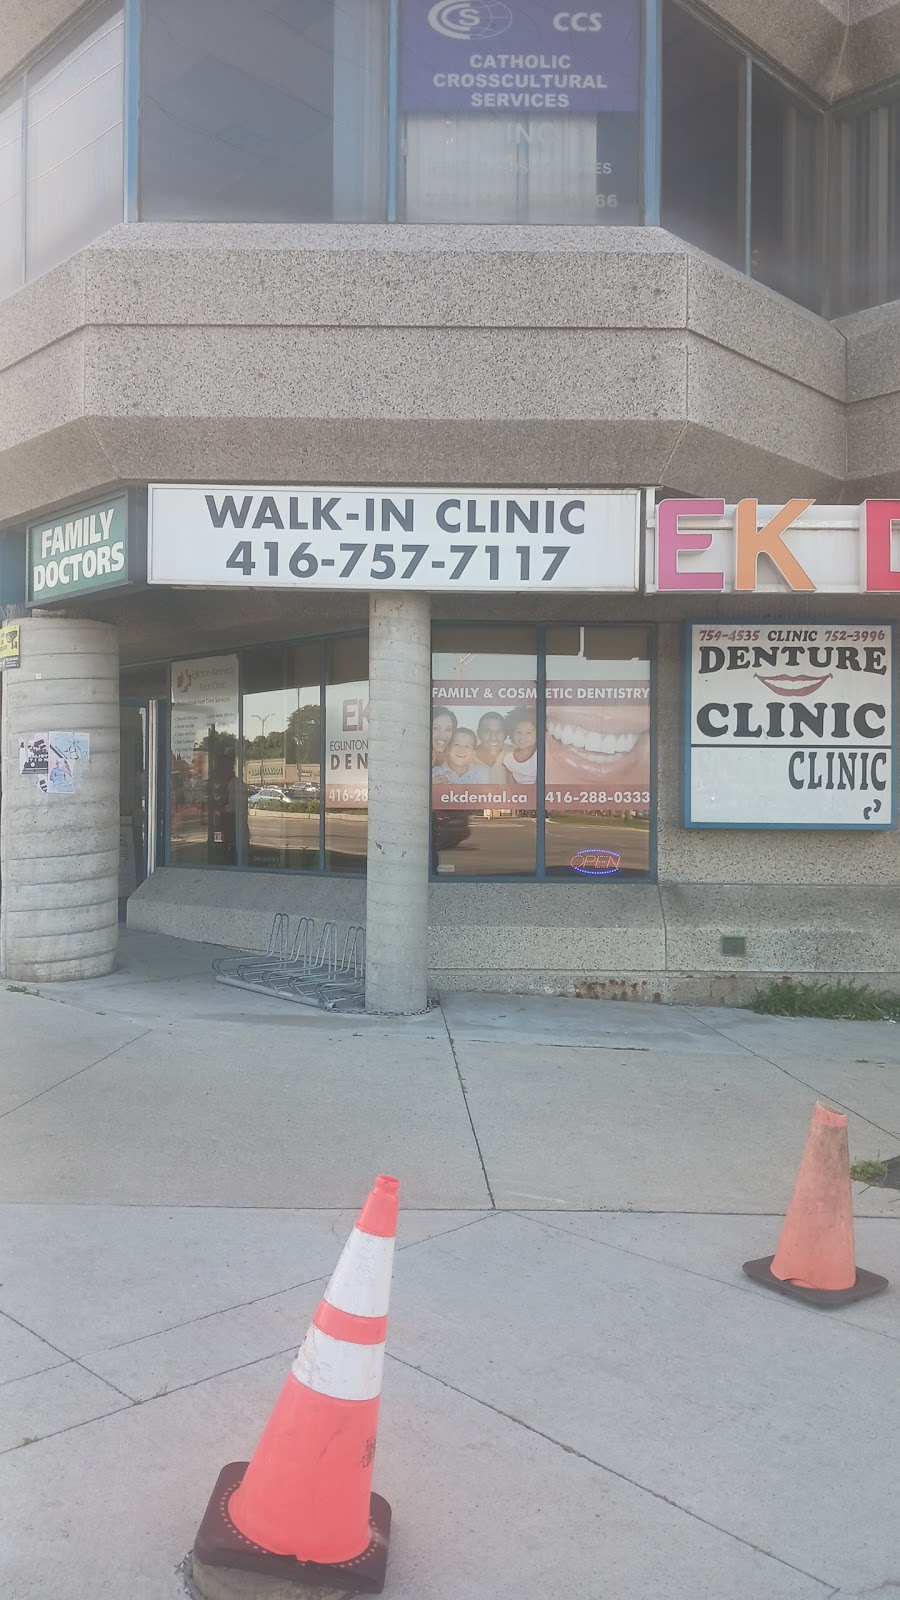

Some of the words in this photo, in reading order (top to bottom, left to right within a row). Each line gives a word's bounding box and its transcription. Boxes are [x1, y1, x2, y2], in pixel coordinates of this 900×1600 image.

[553, 12, 603, 32] CCS
[469, 54, 572, 69] CATHOLIC
[433, 73, 608, 89] CROSSCULTURAL
[470, 92, 570, 108] SERVICES
[204, 494, 414, 533] WALK-IN
[435, 499, 586, 535] CLINIC
[40, 508, 116, 559] FAMILY
[657, 497, 817, 593] EK
[33, 541, 126, 592] DOCTORS
[225, 540, 571, 582] 416-757-7117
[767, 629, 818, 642] CLINIC
[824, 629, 886, 642] 752-3996
[698, 645, 887, 676] DENTURE
[431, 687, 480, 699] FAMILY
[483, 687, 494, 699] &
[577, 687, 650, 699] DENTISTRY
[696, 702, 887, 739] CLINIC
[329, 739, 369, 752] EGLINTON
[788, 750, 888, 792] CLINIC
[440, 790, 528, 804] ekdental.ca
[545, 791, 650, 804] 416-288-0333
[569, 854, 621, 869] OPEN
